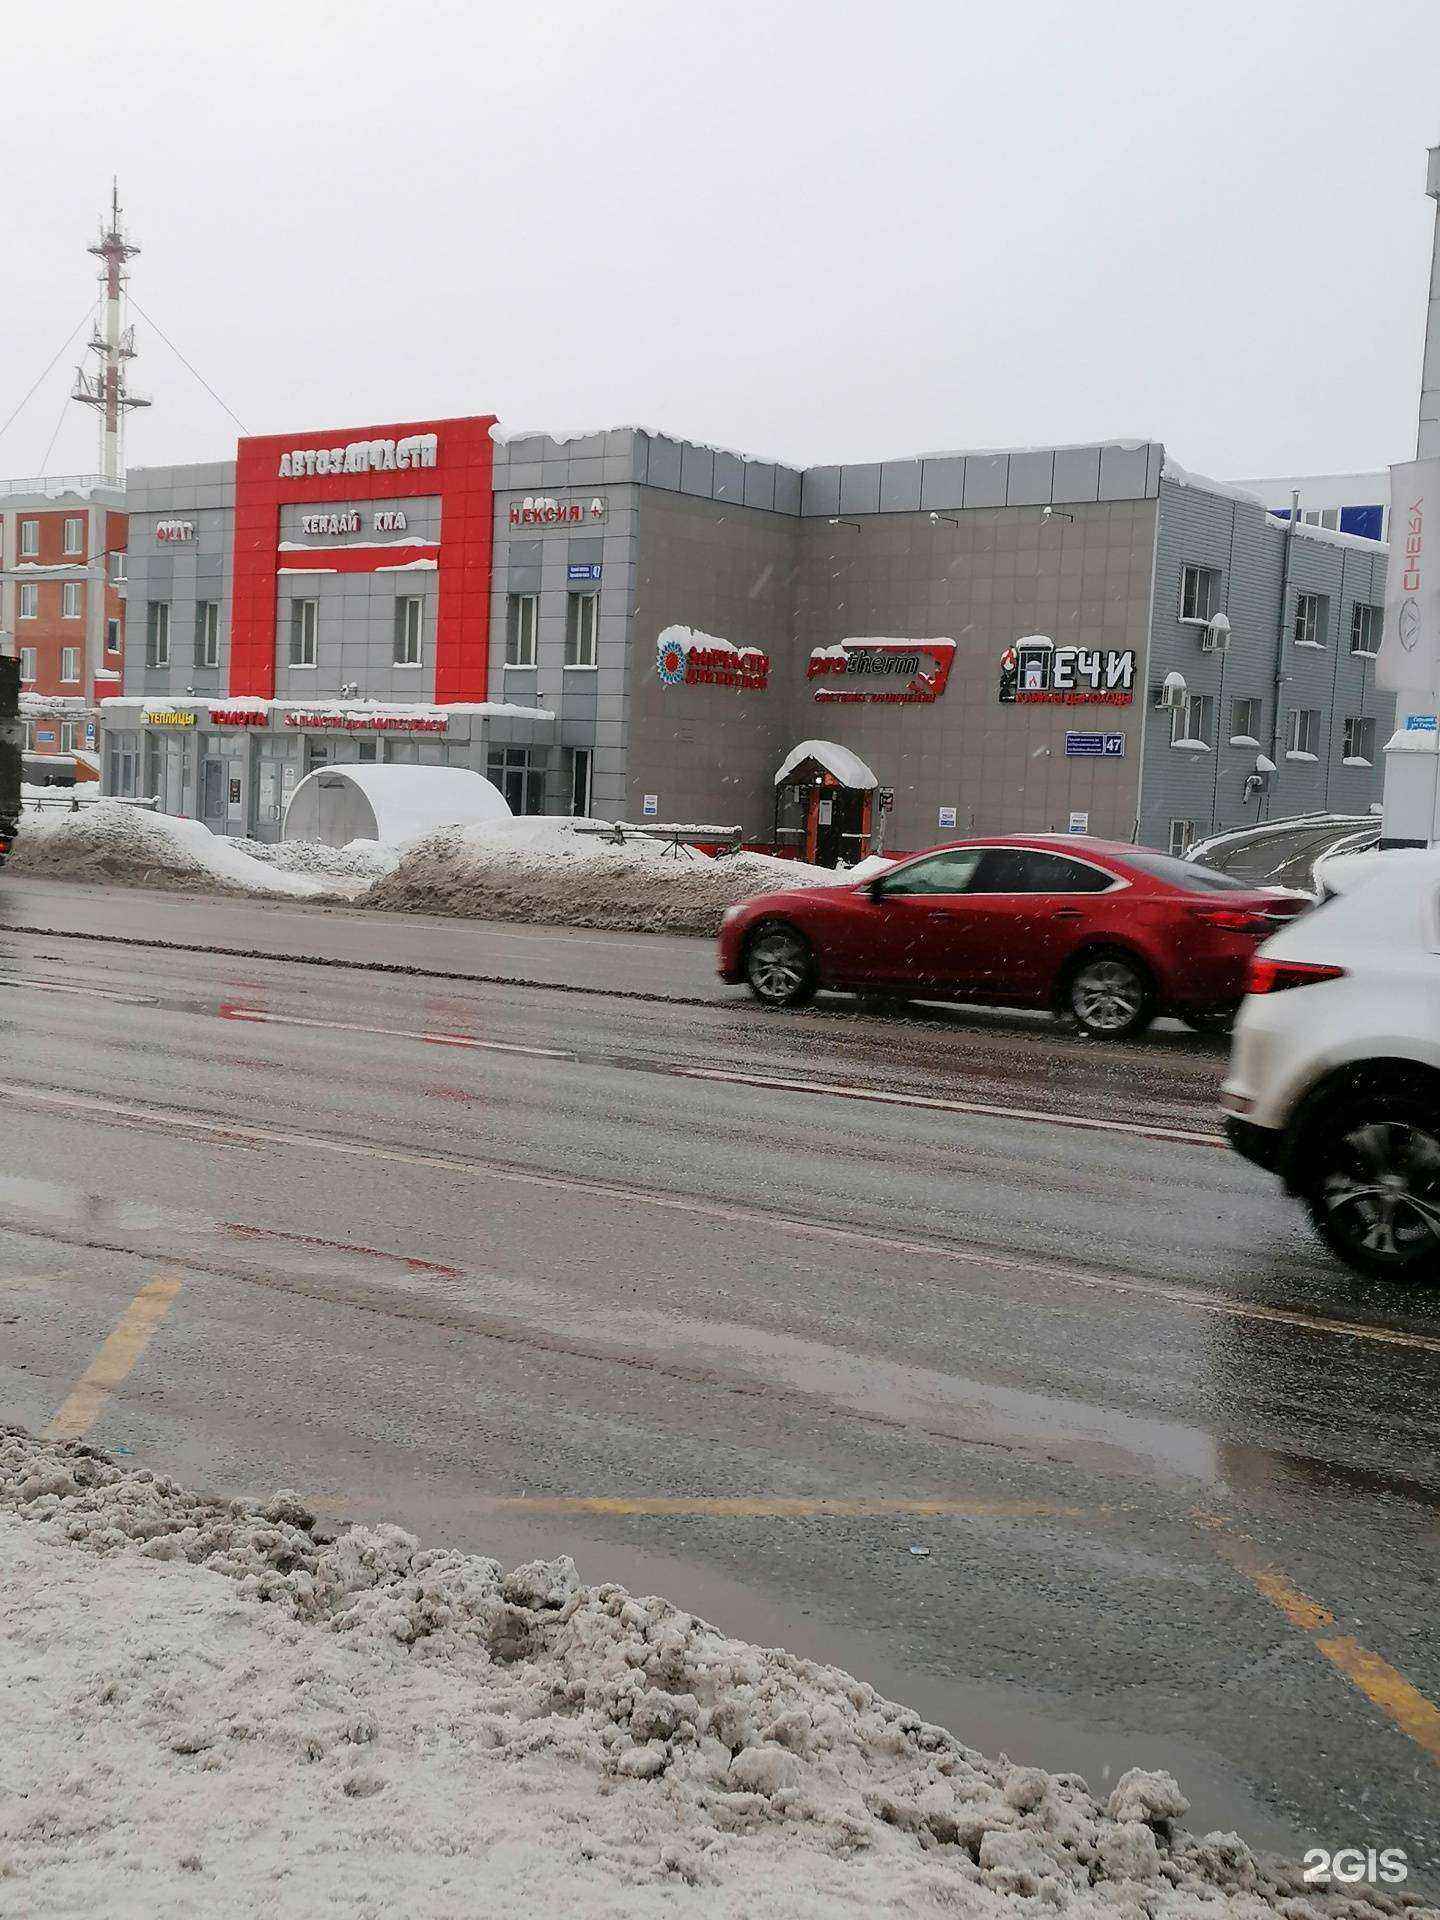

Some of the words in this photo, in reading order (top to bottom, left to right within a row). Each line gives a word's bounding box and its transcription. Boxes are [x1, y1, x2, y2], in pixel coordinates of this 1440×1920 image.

[279, 434, 437, 476] АВТОЗАПЧАСТИ
[302, 510, 361, 535] ХЕНДАЙ
[374, 511, 407, 531] КИА
[509, 502, 583, 524] НЕКСИЯ
[806, 650, 919, 681] protherm
[149, 711, 197, 726] ТЕПЛИЦЫ
[1106, 738, 1121, 751] 47
